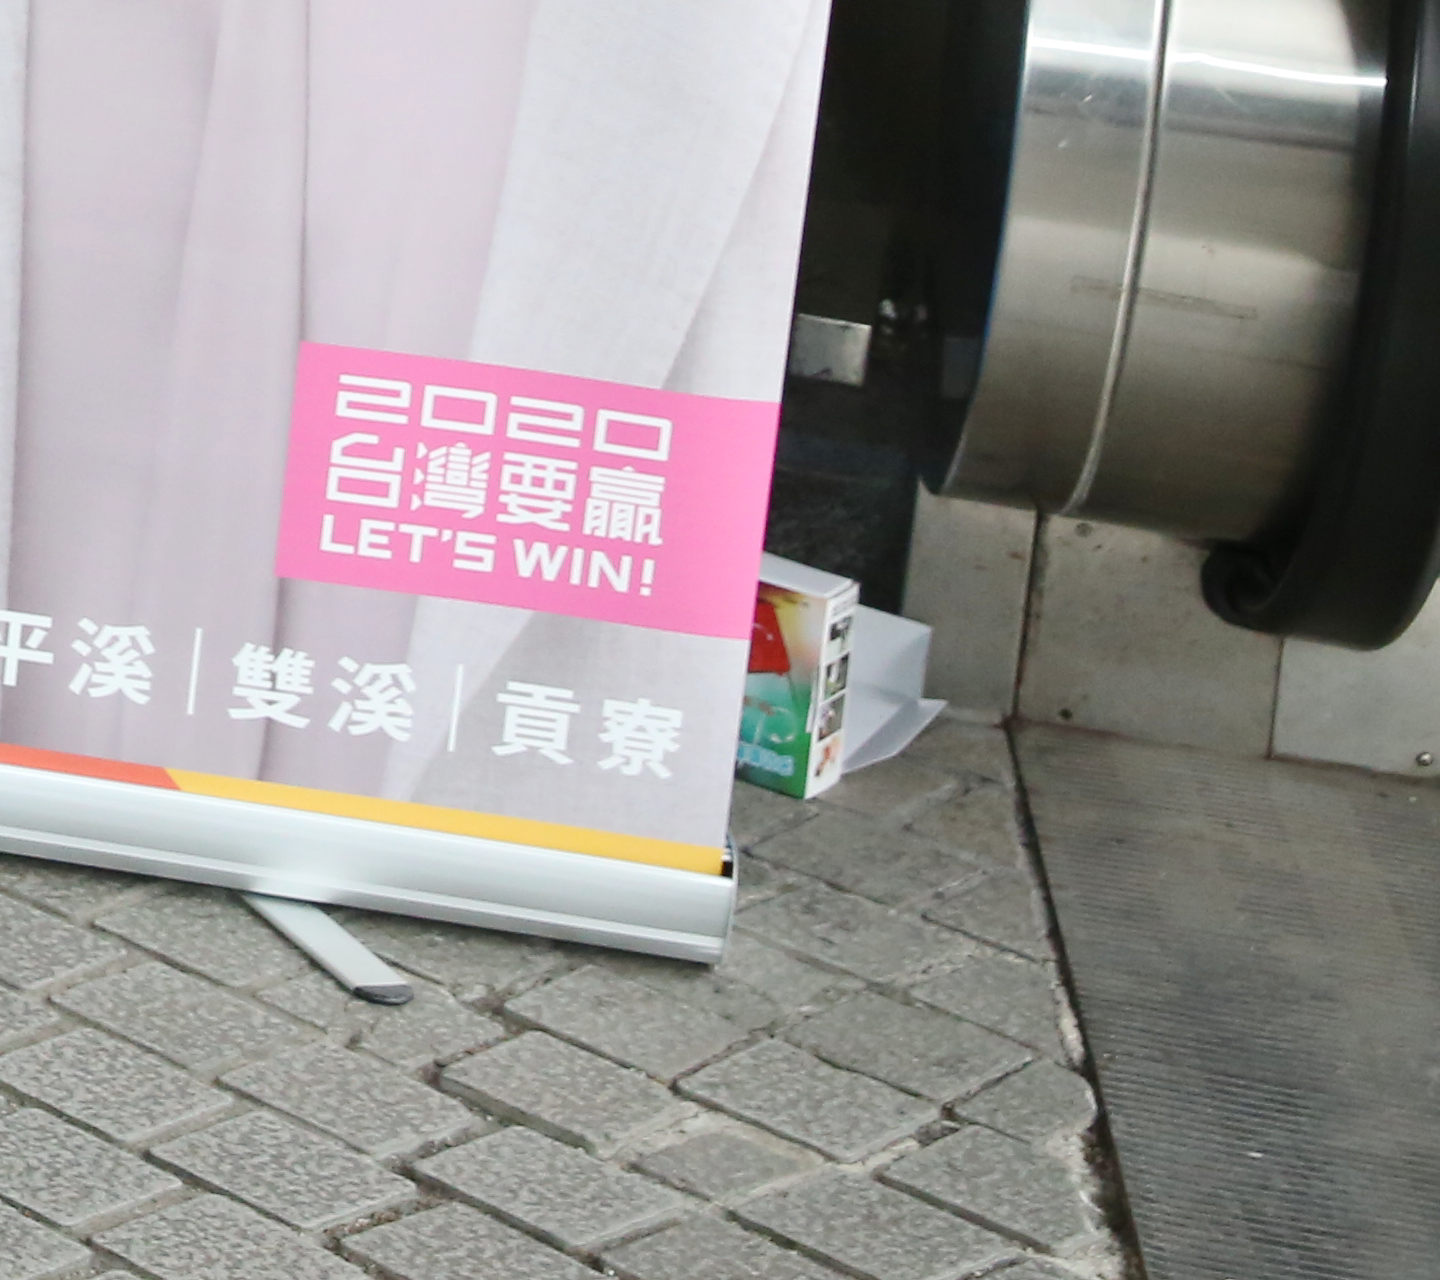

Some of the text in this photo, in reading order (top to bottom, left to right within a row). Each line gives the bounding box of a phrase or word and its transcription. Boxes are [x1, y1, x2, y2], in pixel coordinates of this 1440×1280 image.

[335, 373, 674, 463] 2020
[325, 432, 667, 547] 台灣要贏
[319, 513, 656, 597] LET'S WIN!
[228, 640, 418, 744] 雙溪
[491, 678, 684, 780] 貢寮
